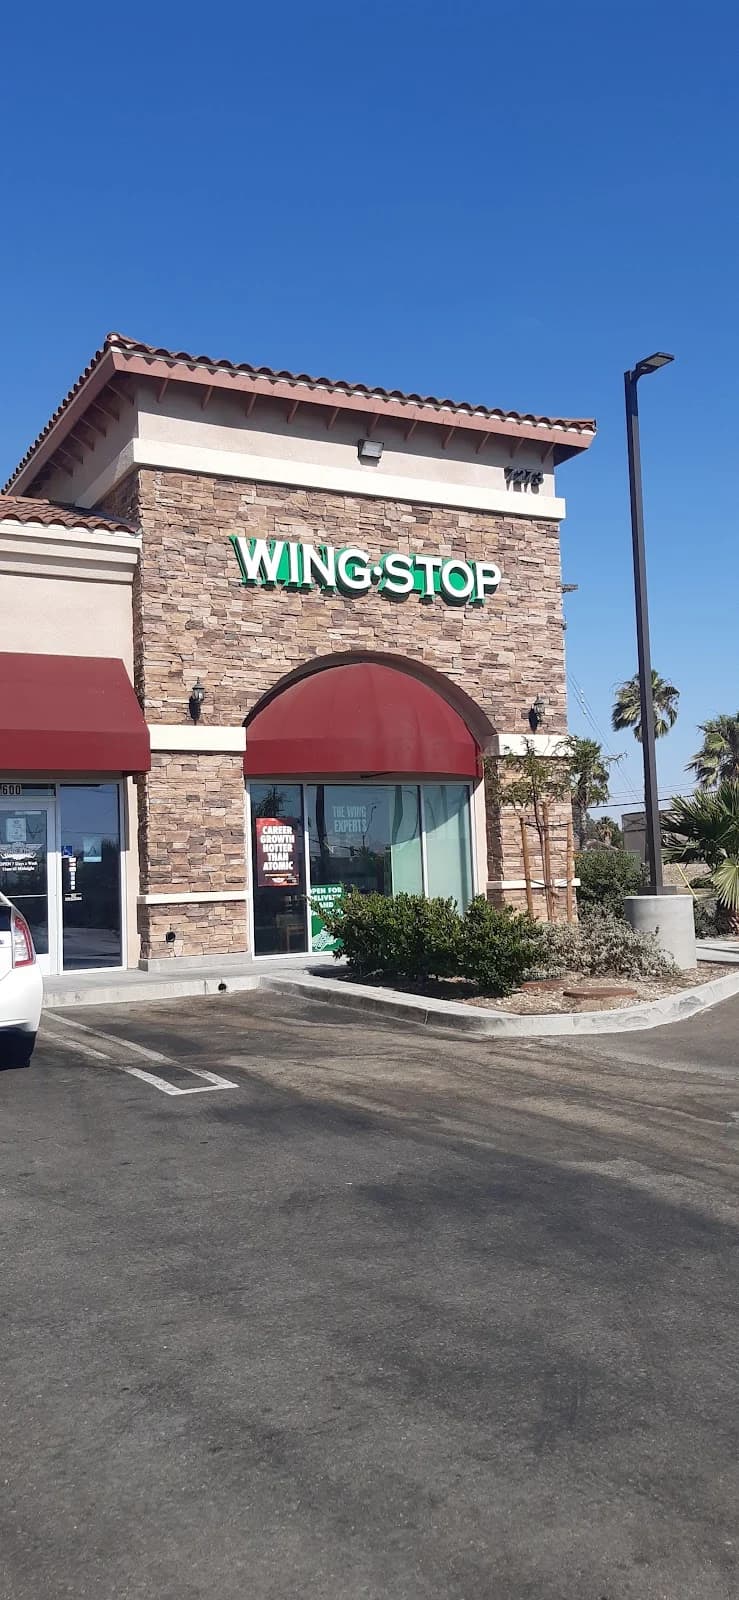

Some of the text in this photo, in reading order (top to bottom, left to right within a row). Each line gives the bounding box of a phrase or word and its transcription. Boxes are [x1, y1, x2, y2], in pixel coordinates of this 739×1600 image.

[2, 784, 21, 795] 600
[332, 806, 367, 818] THE WING
[262, 825, 293, 835] CAREER
[334, 819, 367, 833] EXPERTS
[260, 834, 295, 844] GROWTH
[262, 843, 294, 853] HOTTER
[267, 852, 289, 862] THAN
[262, 861, 294, 871] ATOMIC
[328, 886, 342, 894] FOR
